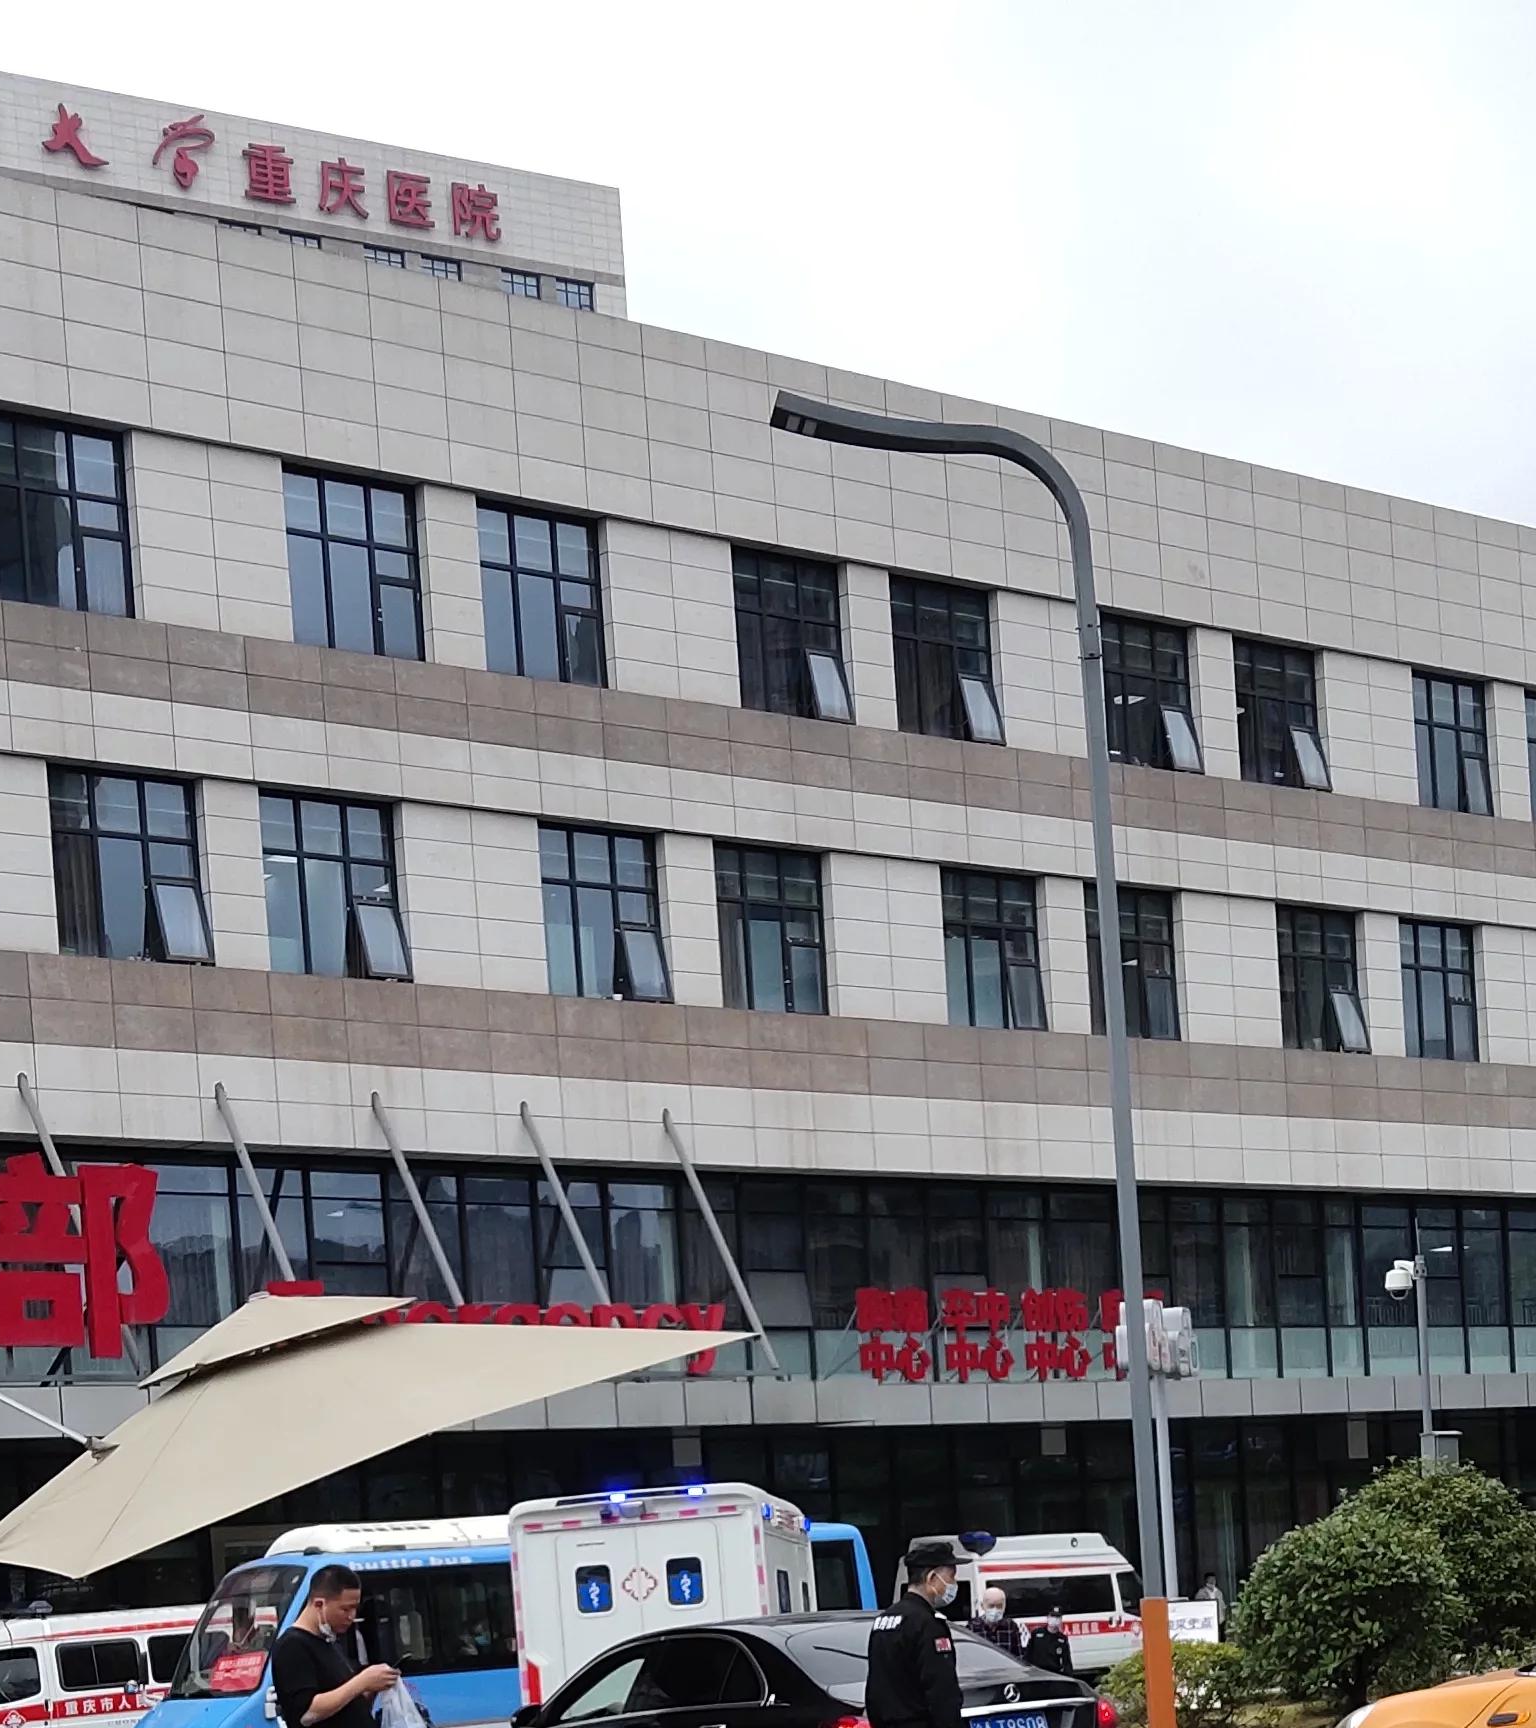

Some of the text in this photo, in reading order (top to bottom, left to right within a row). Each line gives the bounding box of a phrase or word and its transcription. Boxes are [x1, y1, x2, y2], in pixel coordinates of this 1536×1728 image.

[348, 1555, 472, 1571] huttle bus
[65, 1692, 164, 1716] 重庆市人民
